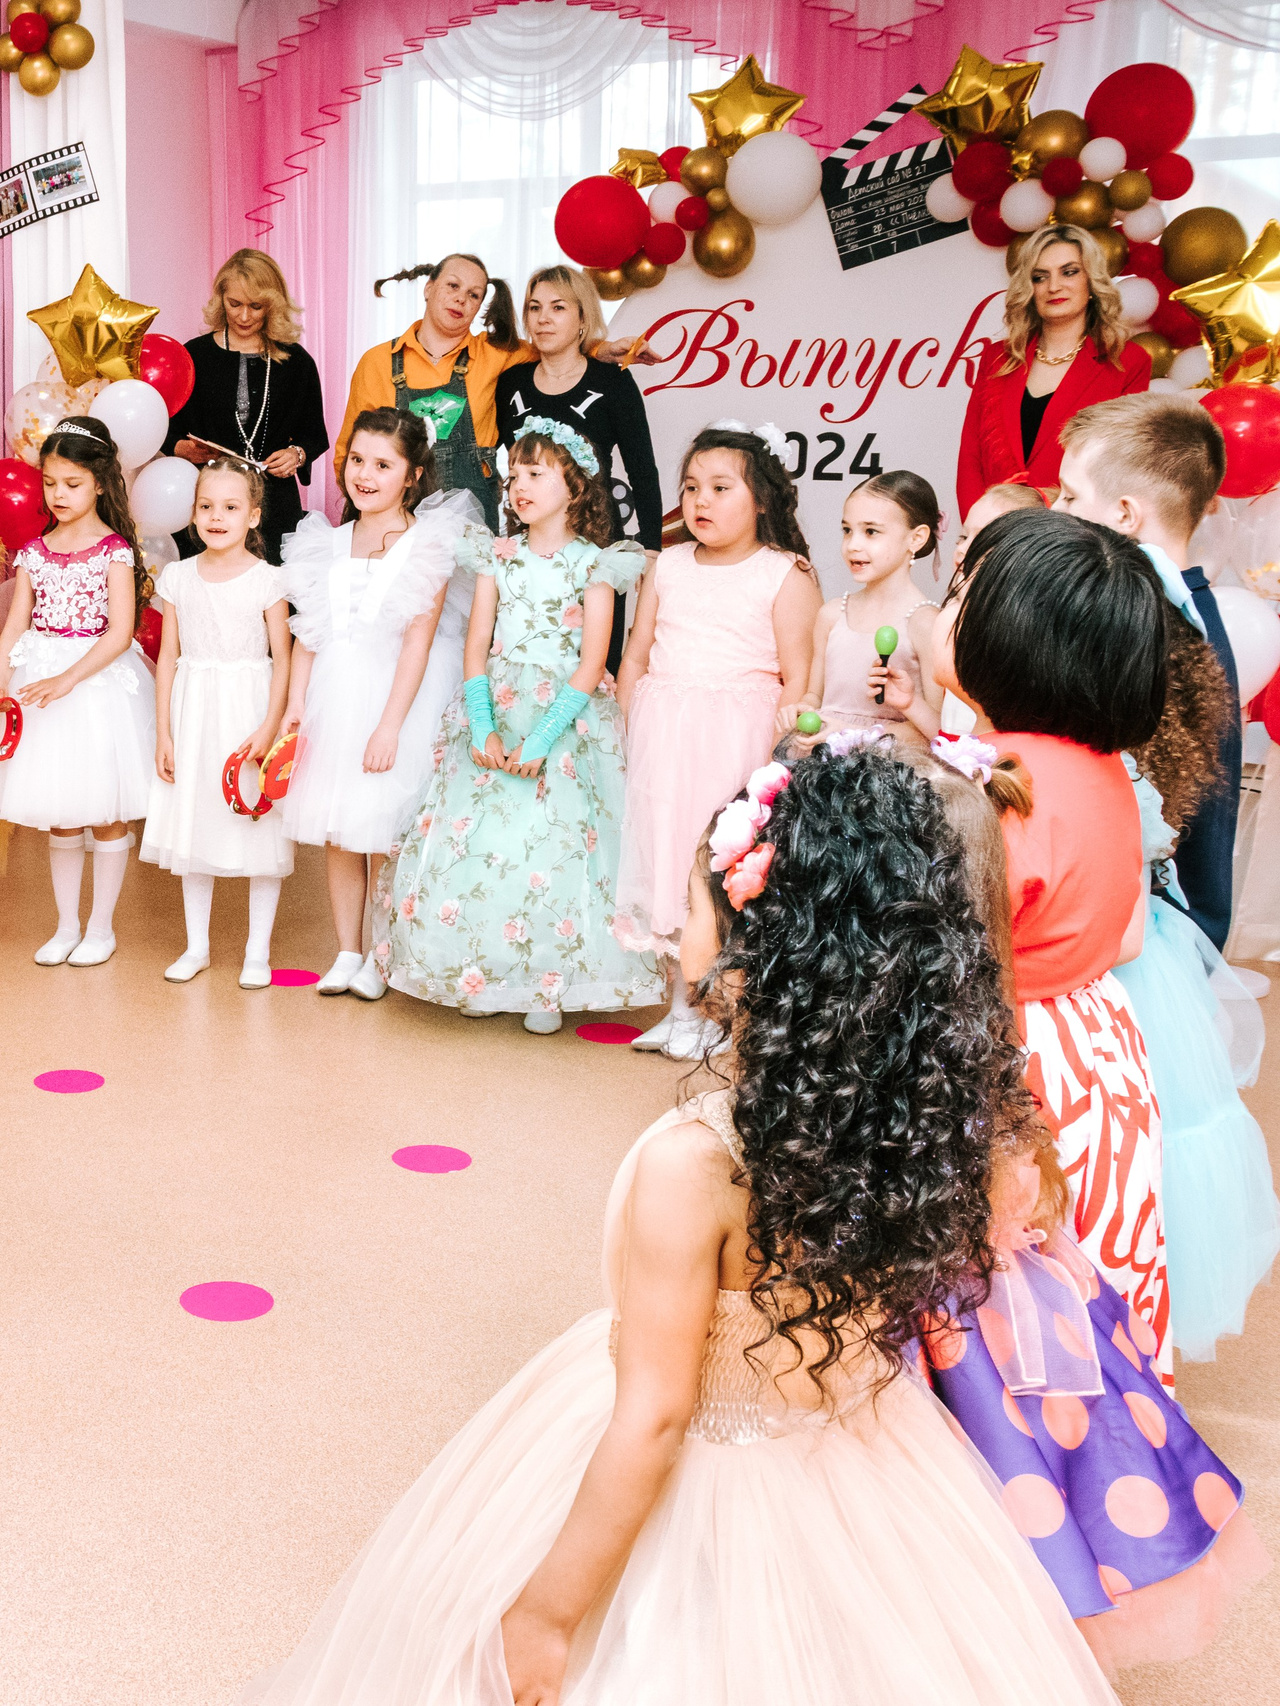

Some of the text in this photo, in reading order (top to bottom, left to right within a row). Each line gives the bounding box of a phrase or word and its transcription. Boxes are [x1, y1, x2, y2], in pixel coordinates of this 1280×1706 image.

[848, 178, 885, 201] Детский
[886, 171, 900, 186] сад
[915, 163, 927, 177] 27
[874, 207, 887, 218] 23
[889, 202, 905, 213] мая
[907, 195, 924, 207] 202
[901, 208, 929, 224] Пчёлк
[890, 240, 898, 253] 7
[785, 431, 883, 481] 024
